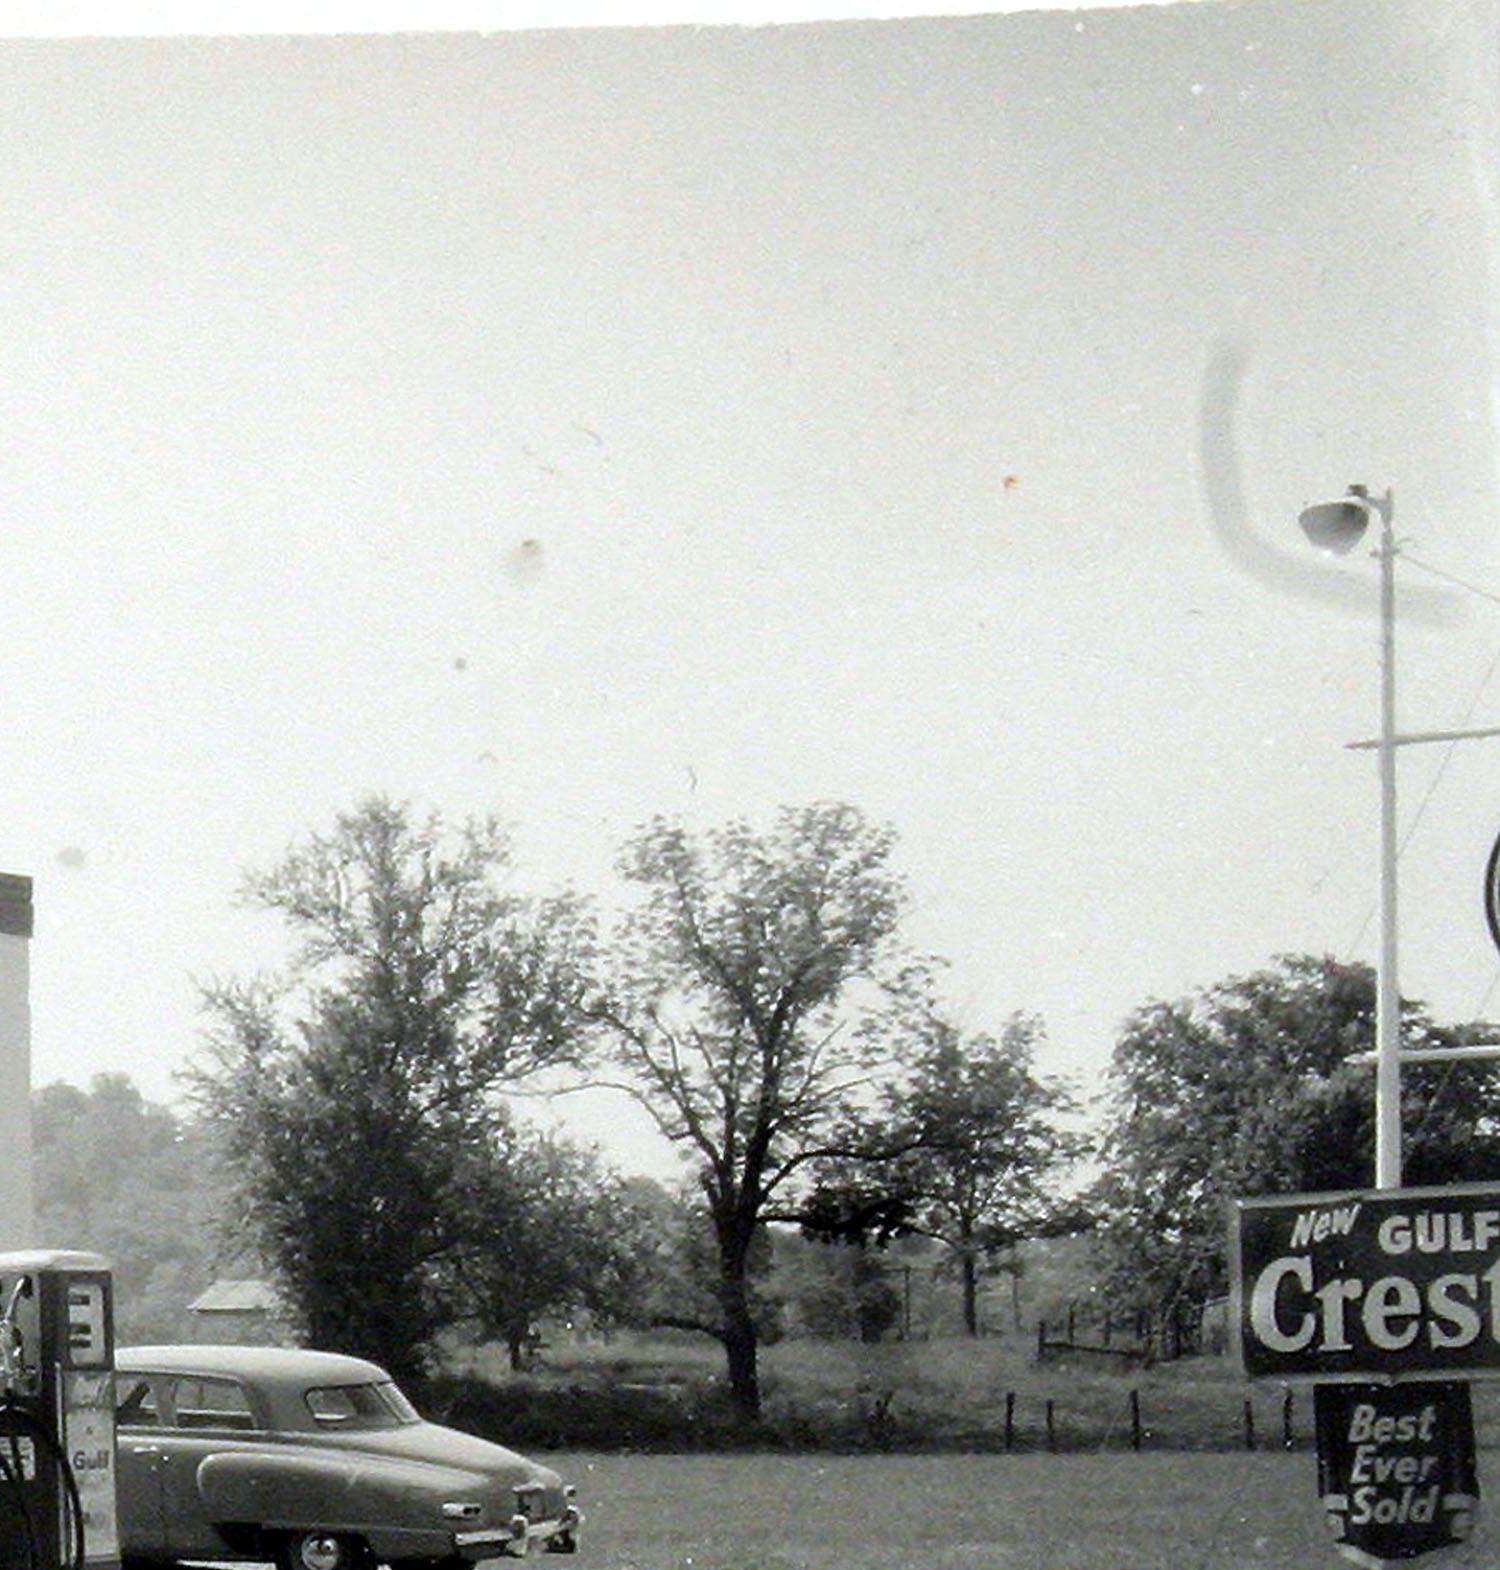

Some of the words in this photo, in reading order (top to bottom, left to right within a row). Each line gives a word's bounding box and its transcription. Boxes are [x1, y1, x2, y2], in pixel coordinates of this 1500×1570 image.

[1290, 1202, 1362, 1248] New
[1378, 1210, 1500, 1254] GULF
[1347, 1404, 1436, 1442] Best
[1350, 1444, 1439, 1484] Ever
[1351, 1484, 1440, 1524] Sold
